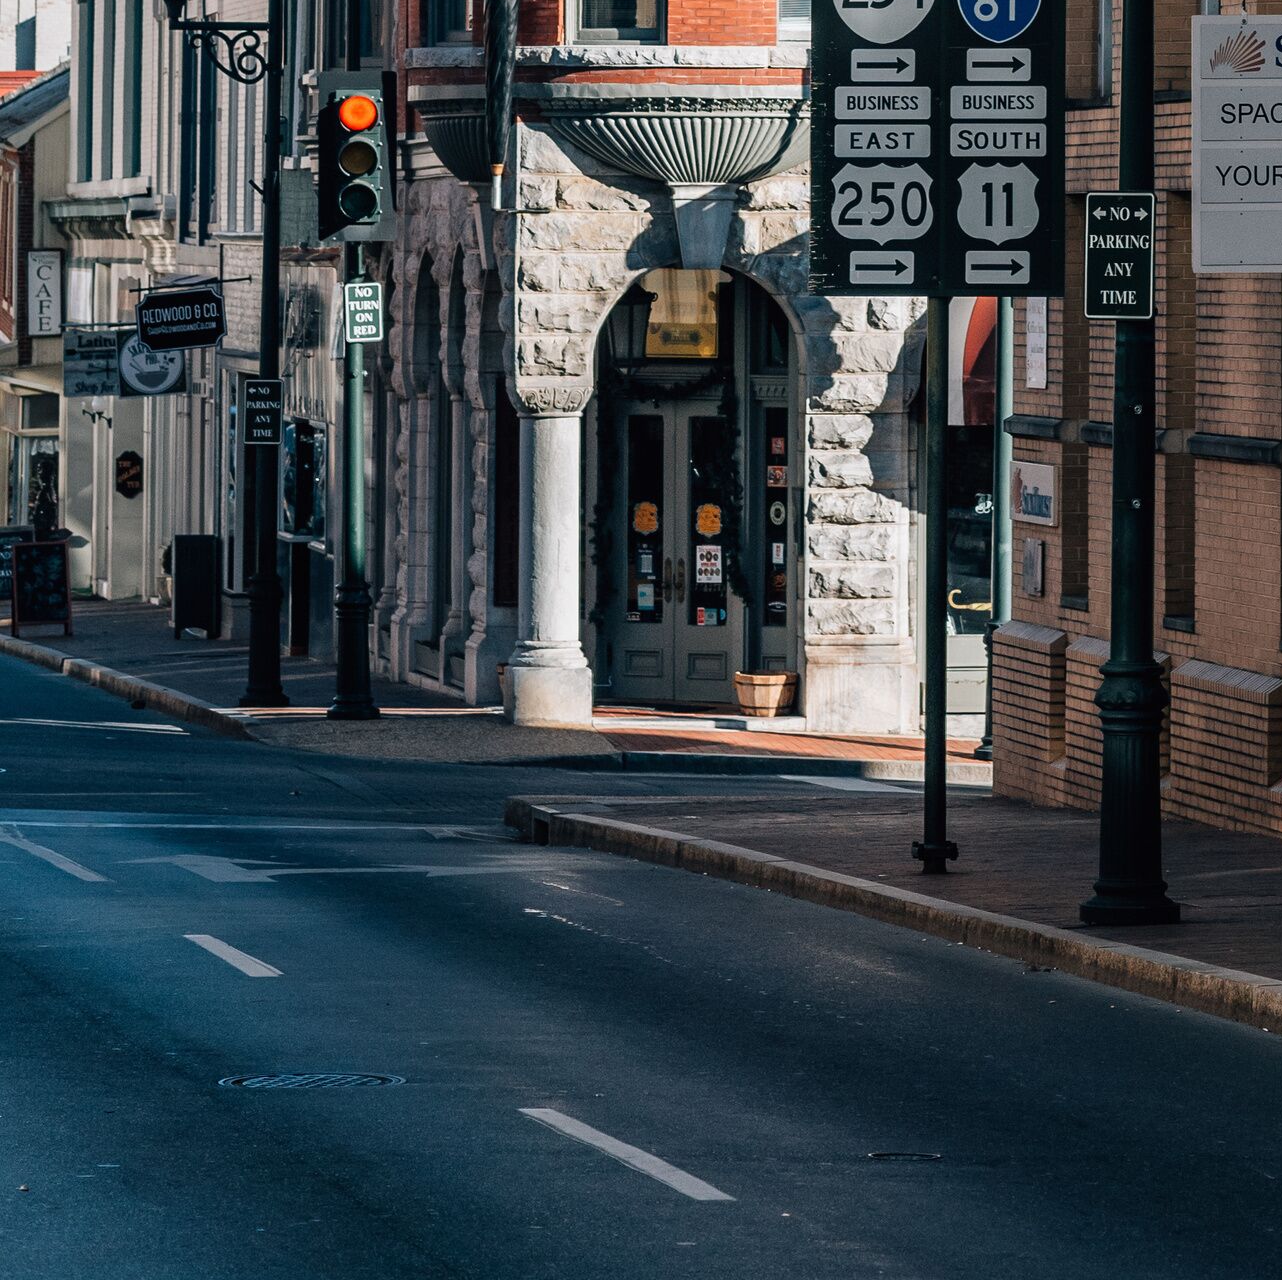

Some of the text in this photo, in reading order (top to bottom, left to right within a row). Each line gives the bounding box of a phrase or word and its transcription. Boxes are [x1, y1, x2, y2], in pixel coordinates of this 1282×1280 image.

[846, 95, 919, 111] BUSINESS
[962, 94, 1035, 111] BUSINESS
[849, 131, 915, 150] EAST
[956, 130, 1041, 150] SOUTH
[837, 180, 927, 227] 250
[981, 182, 1013, 227] 11
[1110, 206, 1131, 221] NO
[1089, 234, 1150, 249] PARKING
[1104, 262, 1134, 277] ANY
[35, 265, 52, 332] CAFE
[354, 287, 373, 298] NO
[1100, 290, 1137, 305] TIME
[142, 302, 220, 324] REDWOOD & CO.
[348, 300, 379, 311] TURN
[355, 312, 373, 322] ON
[353, 325, 376, 336] RED
[257, 387, 270, 395] NO
[246, 401, 281, 409] PARKING
[254, 415, 271, 423] ANY
[252, 429, 273, 437] TIME
